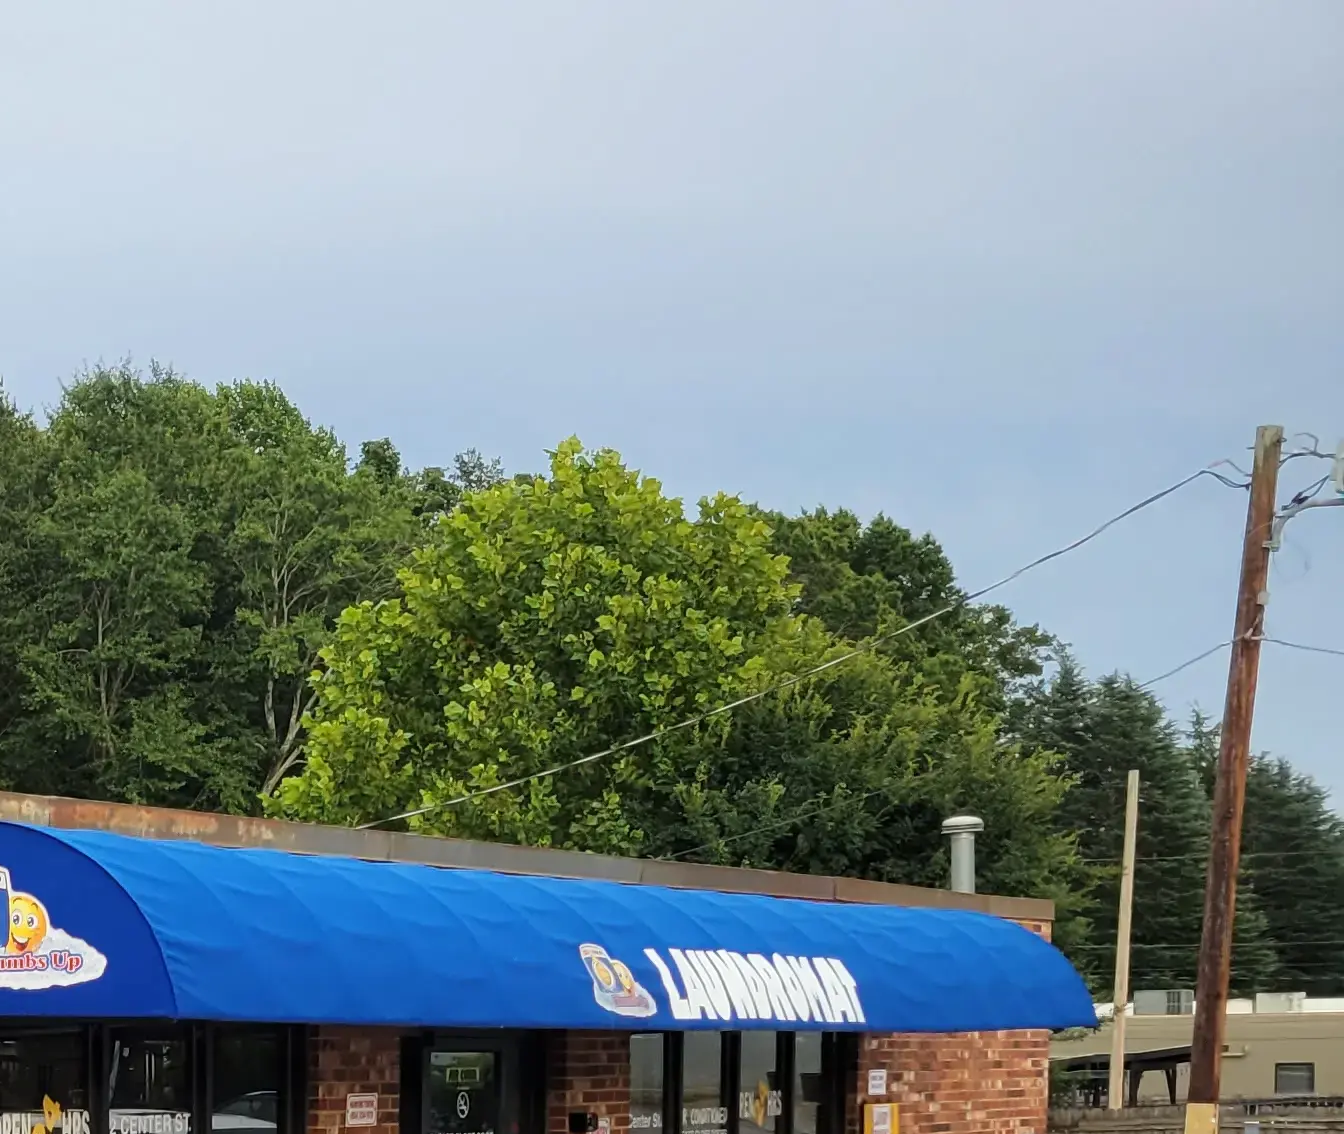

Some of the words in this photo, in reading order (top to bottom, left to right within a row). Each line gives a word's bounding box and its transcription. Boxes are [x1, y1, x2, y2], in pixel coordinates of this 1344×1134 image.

[50, 950, 83, 974] Up
[644, 948, 866, 1023] LAUNDROMAT
[739, 1092, 756, 1118] PEN
[176, 1112, 192, 1132] ST.
